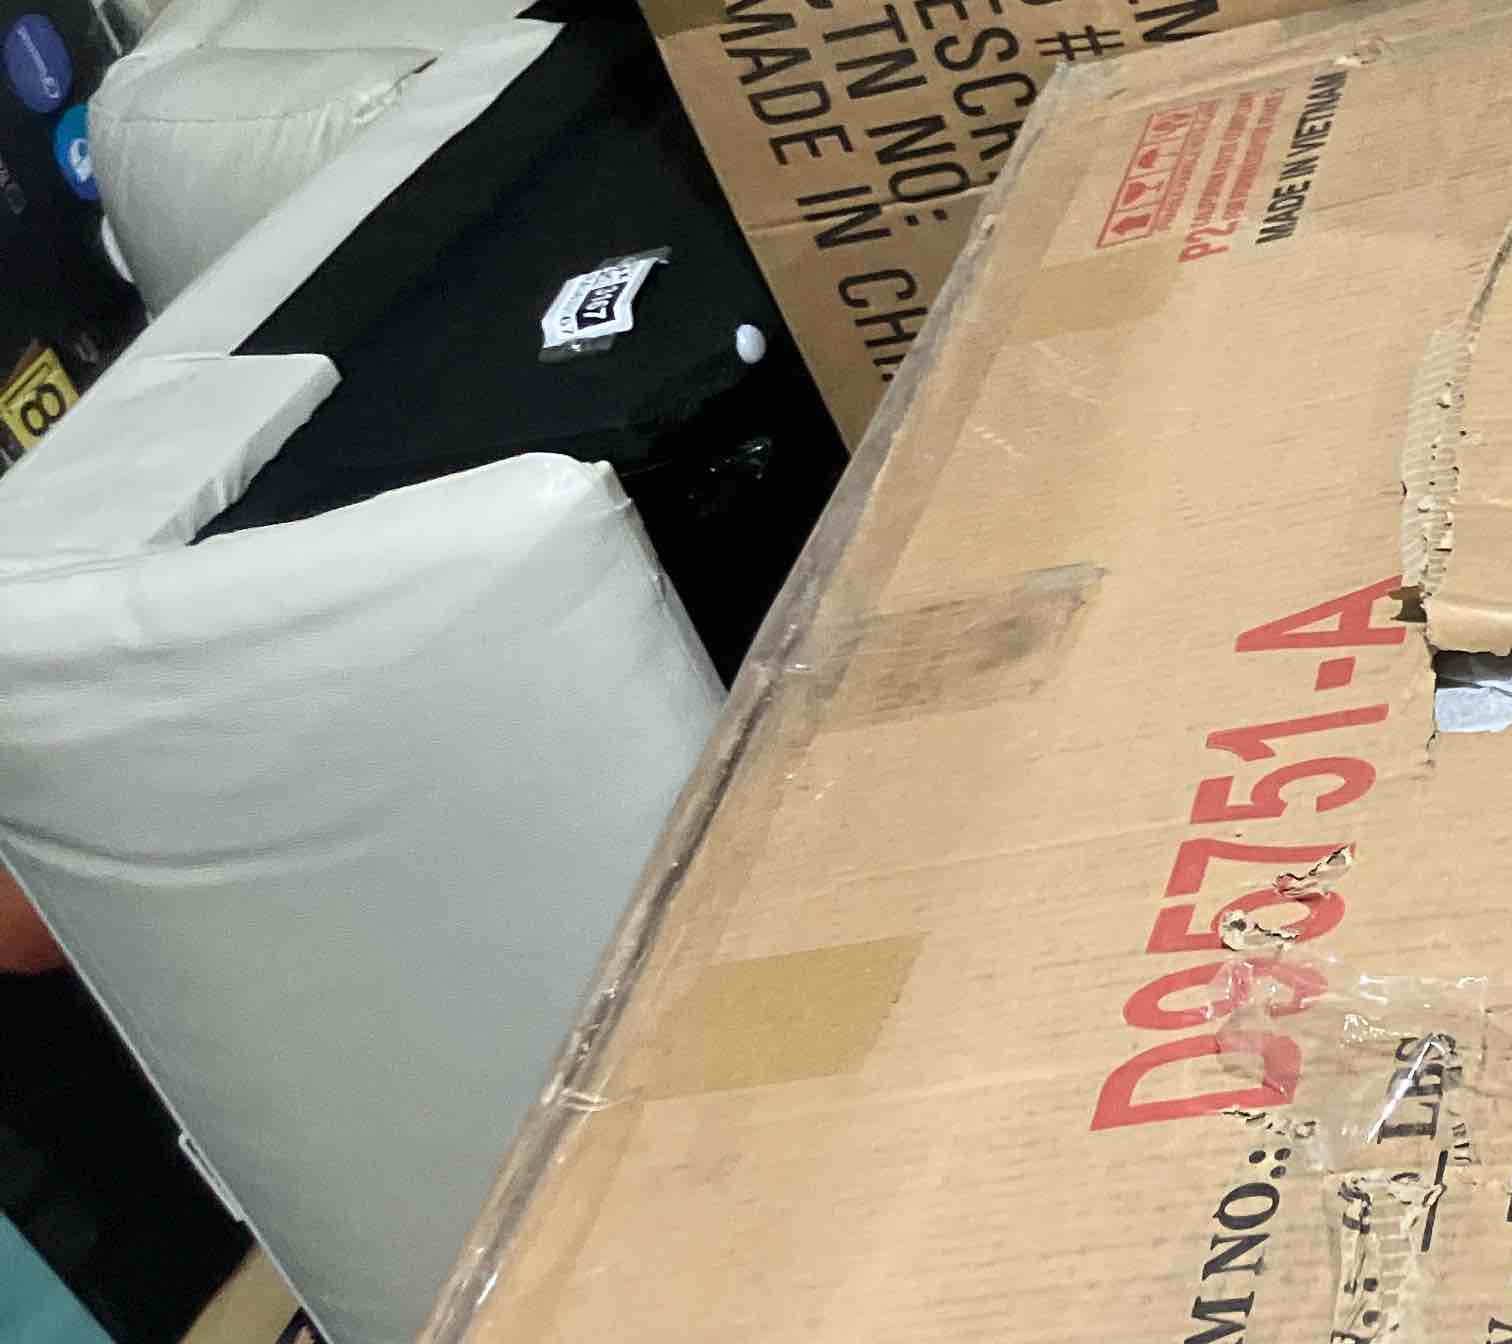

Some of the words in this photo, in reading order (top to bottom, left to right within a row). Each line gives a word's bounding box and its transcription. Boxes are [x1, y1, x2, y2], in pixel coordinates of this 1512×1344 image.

[1035, 25, 1126, 61] #
[1287, 70, 1348, 158] VIETNAM
[866, 113, 972, 226] NO:
[1280, 154, 1320, 184] IN
[797, 185, 891, 249] IN
[1256, 179, 1312, 244] MADE
[1089, 575, 1408, 1131] D95751-A
